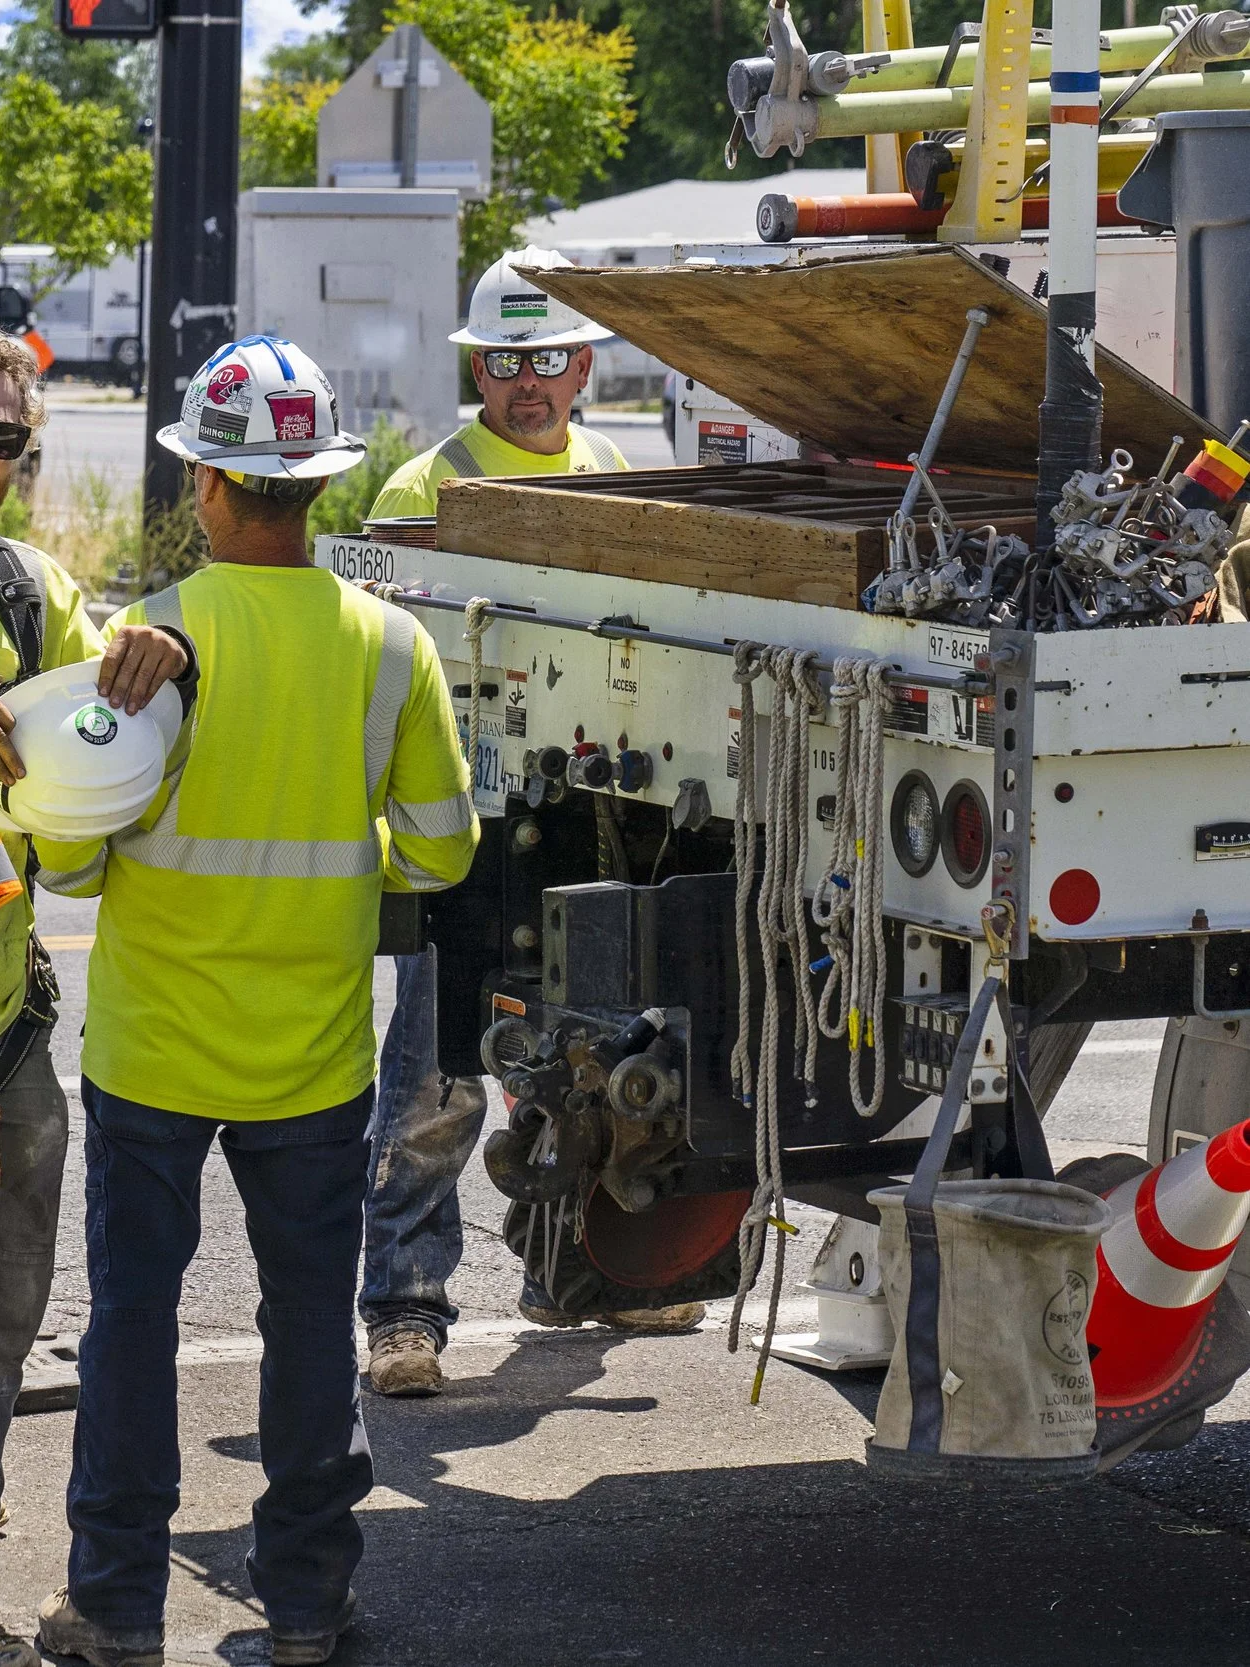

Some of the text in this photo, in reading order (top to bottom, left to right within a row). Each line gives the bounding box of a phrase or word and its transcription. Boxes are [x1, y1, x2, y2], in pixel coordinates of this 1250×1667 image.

[715, 424, 735, 435] DANGER
[707, 437, 741, 447] ELECTRICAL HAZARD
[331, 544, 394, 583] 1051680
[620, 657, 630, 670] NO
[612, 678, 638, 694] ACCESS
[1039, 1412, 1055, 1425] 75
